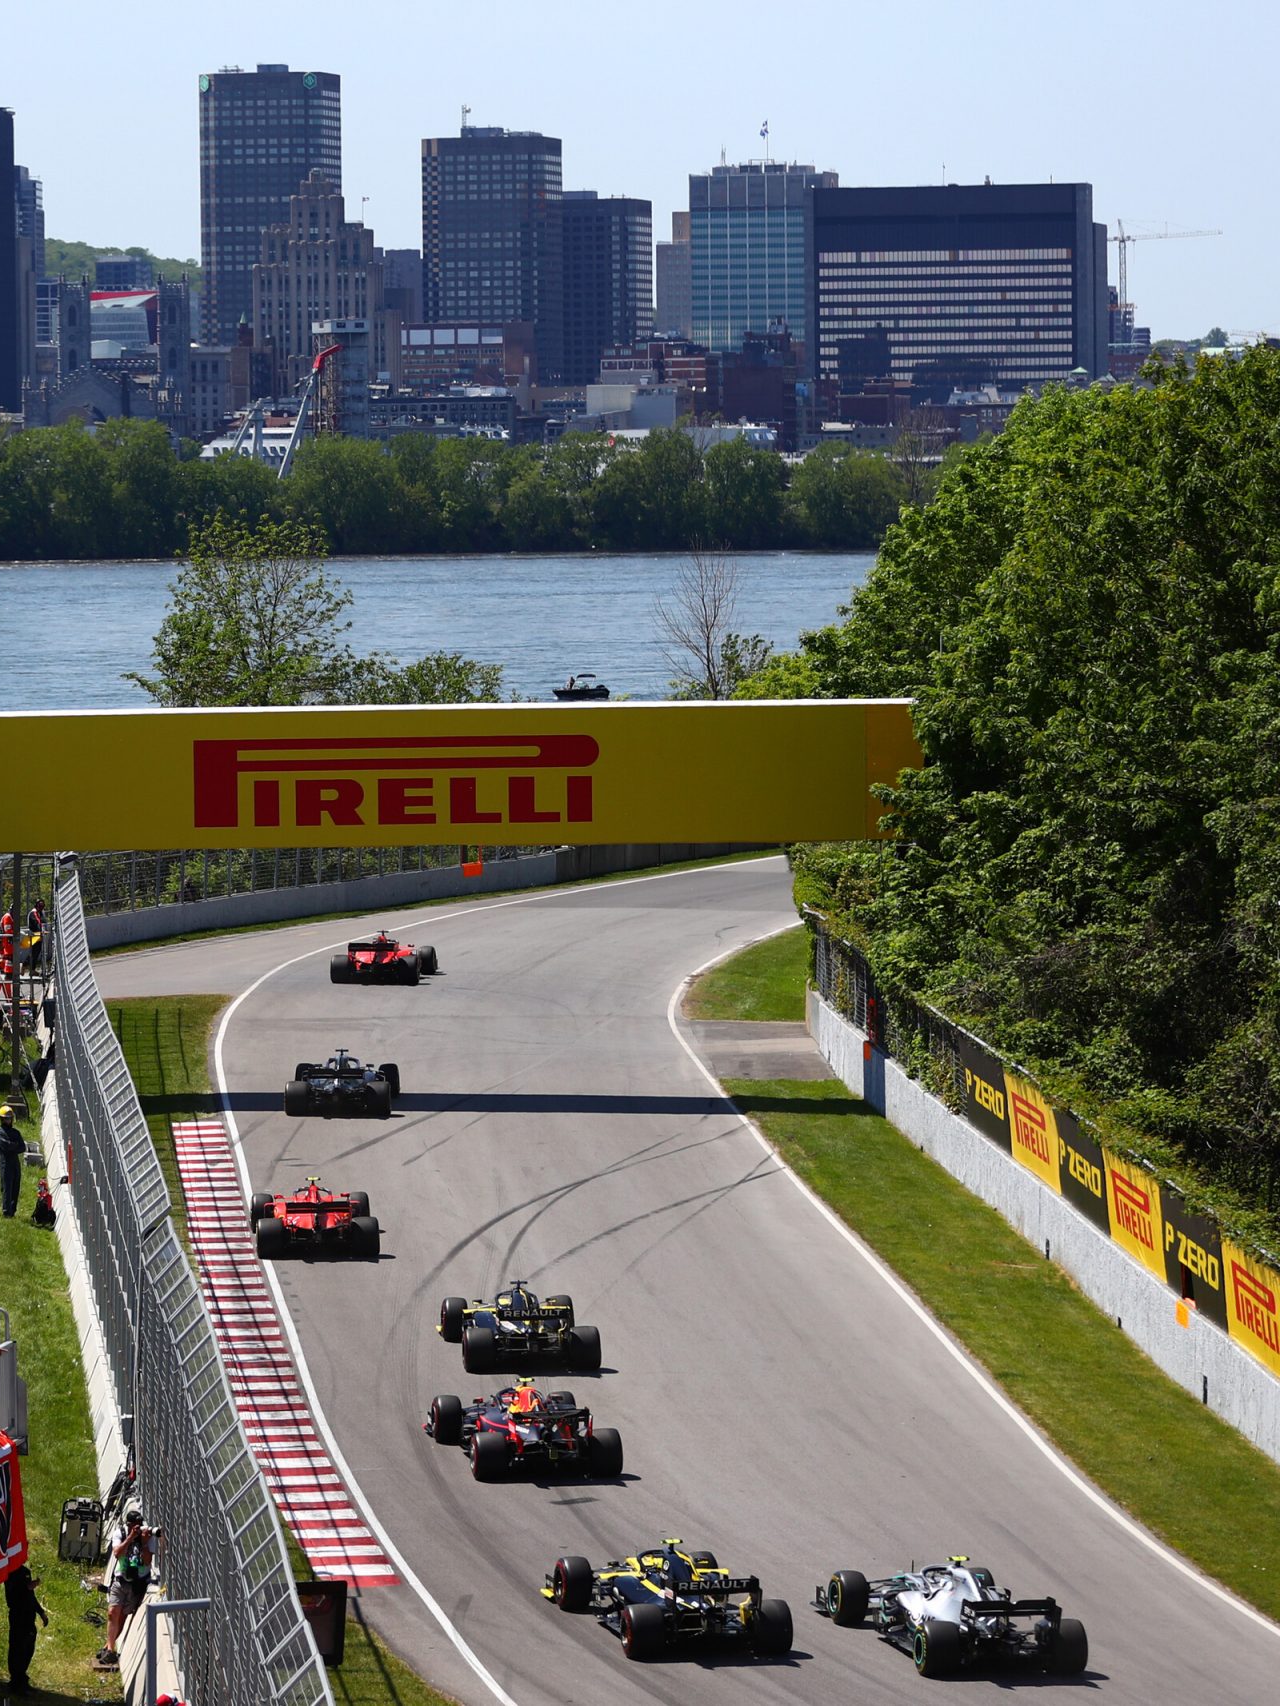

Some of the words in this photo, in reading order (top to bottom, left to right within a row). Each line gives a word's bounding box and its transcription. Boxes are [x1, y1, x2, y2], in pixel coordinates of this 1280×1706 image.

[193, 734, 600, 828] PIRELLI
[965, 1068, 972, 1094] P
[973, 1074, 1004, 1120] ZERO
[1011, 1091, 1050, 1165] PIRELLI
[1059, 1137, 1066, 1166] P
[1067, 1145, 1102, 1198] ZERO
[1111, 1169, 1154, 1251] PIRELLI
[1165, 1220, 1175, 1252] P
[1177, 1230, 1219, 1291] ZERO
[503, 1309, 562, 1318] RENAULT
[1231, 1259, 1280, 1355] PIRELLI
[679, 1579, 750, 1591] RENAULT
